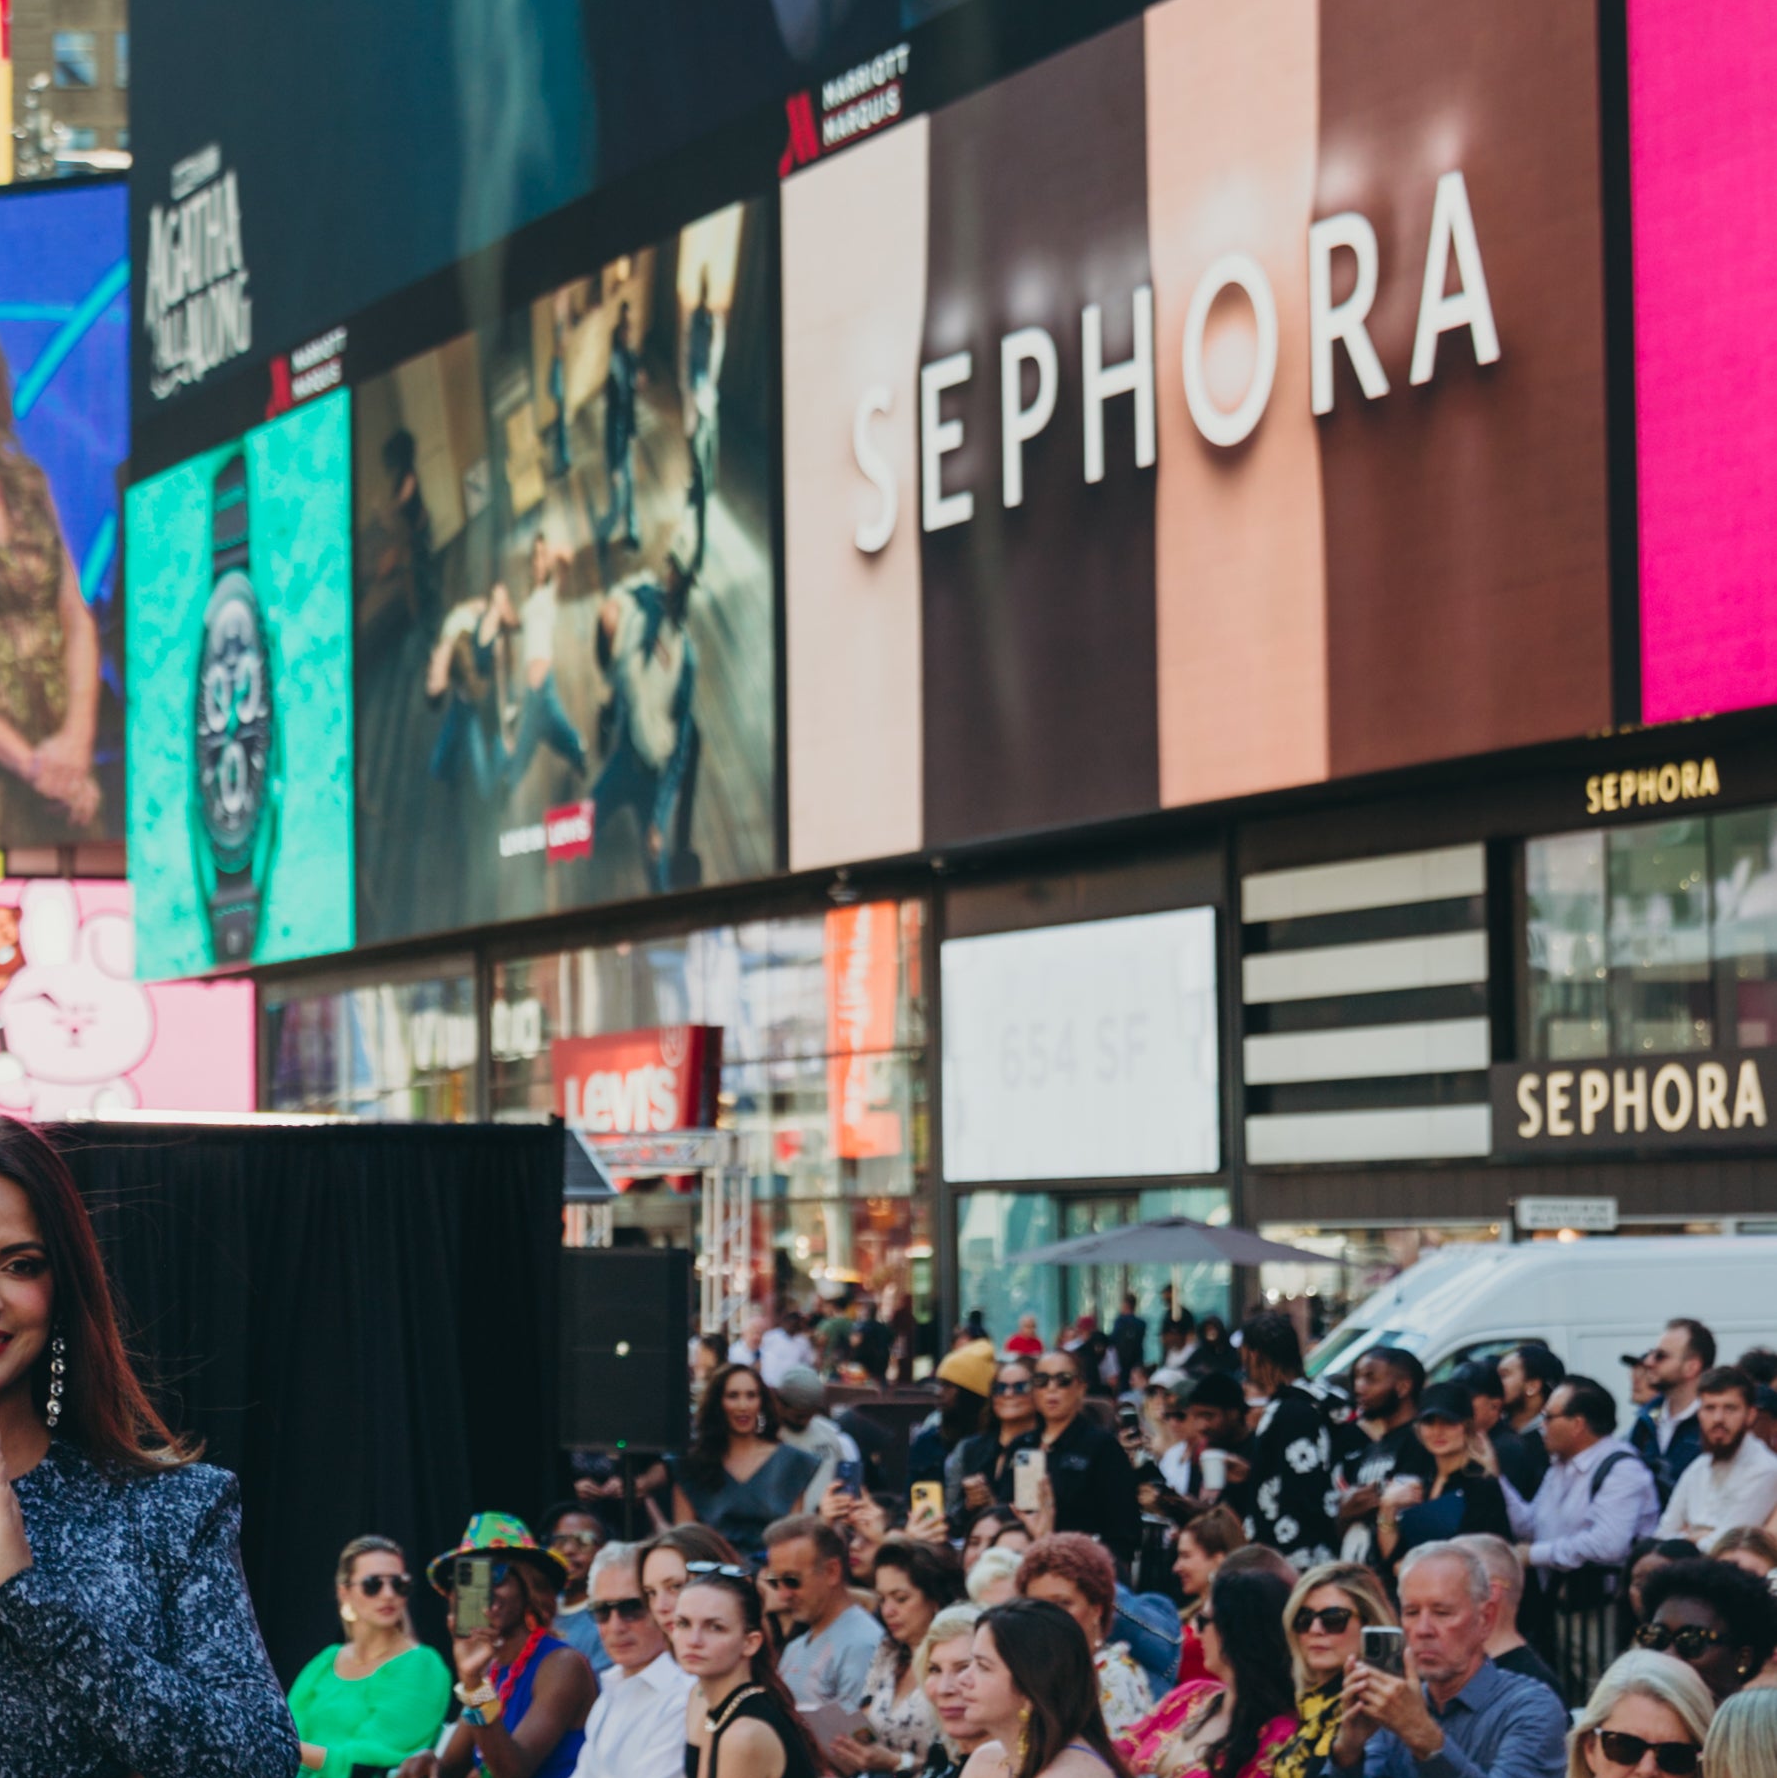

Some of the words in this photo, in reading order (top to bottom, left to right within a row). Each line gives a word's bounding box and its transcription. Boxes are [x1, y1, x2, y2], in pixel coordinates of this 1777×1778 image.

[822, 41, 911, 112] MARRIOTT
[822, 83, 901, 147] MARQUIS
[143, 170, 244, 331] AGATHA
[852, 168, 1503, 554] SEPHORA
[1586, 757, 1720, 815] SEPHORA
[1094, 1010, 1151, 1084] SF
[1517, 1059, 1768, 1139] SEPHORA
